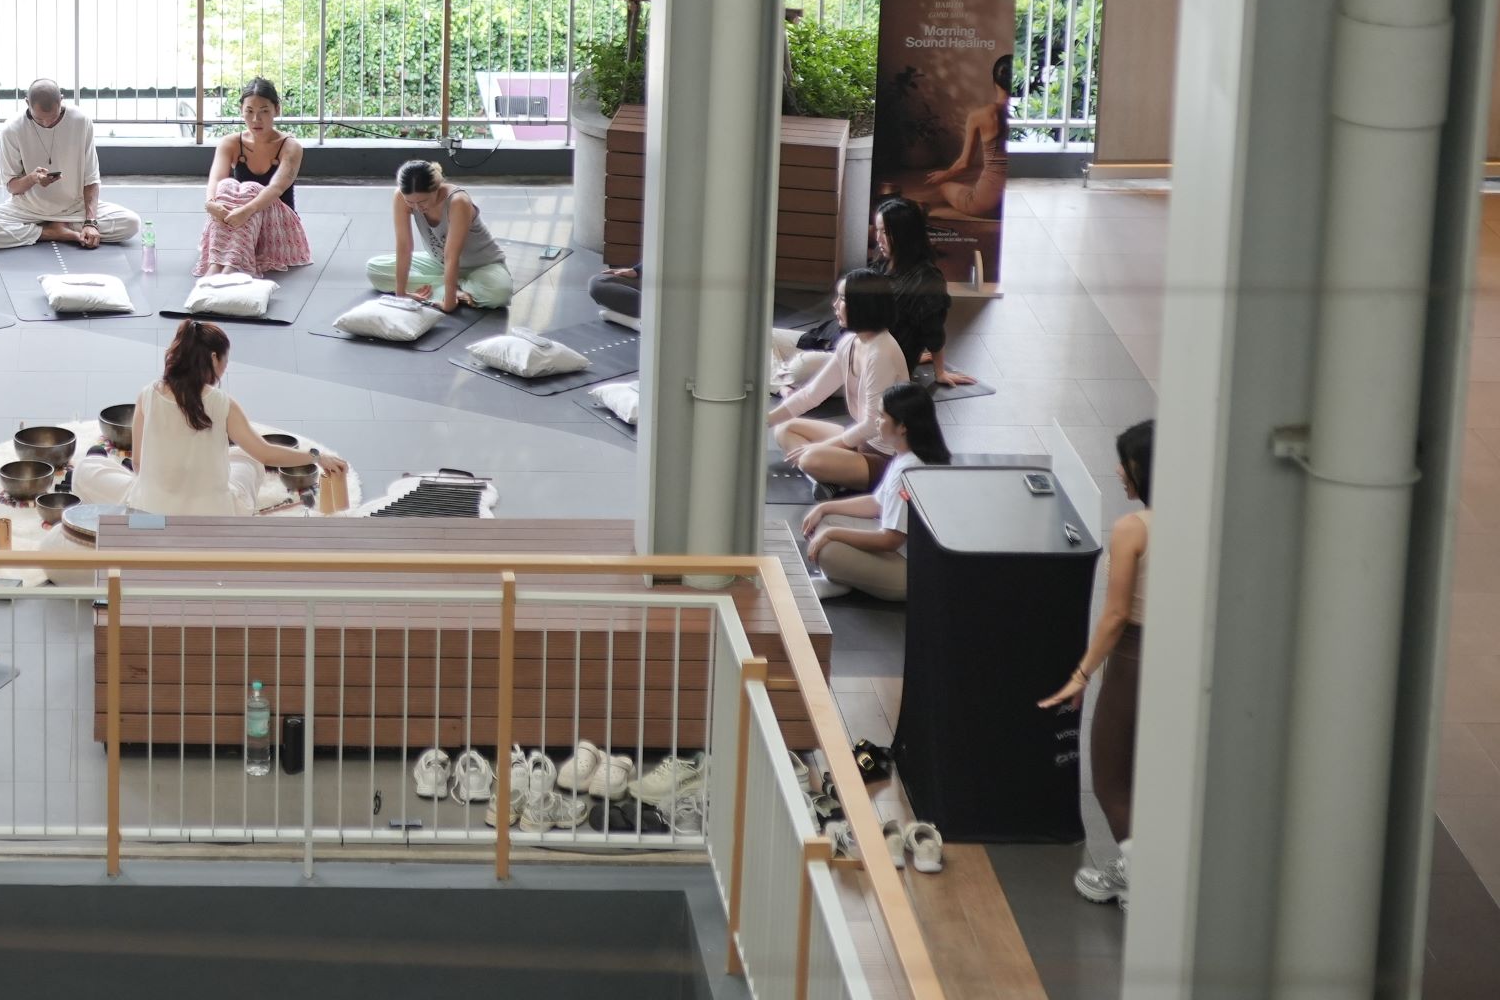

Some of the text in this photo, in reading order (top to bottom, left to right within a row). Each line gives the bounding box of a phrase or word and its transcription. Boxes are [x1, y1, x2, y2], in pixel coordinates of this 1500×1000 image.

[924, 25, 976, 39] Morning
[905, 36, 996, 50] Sound Healing
